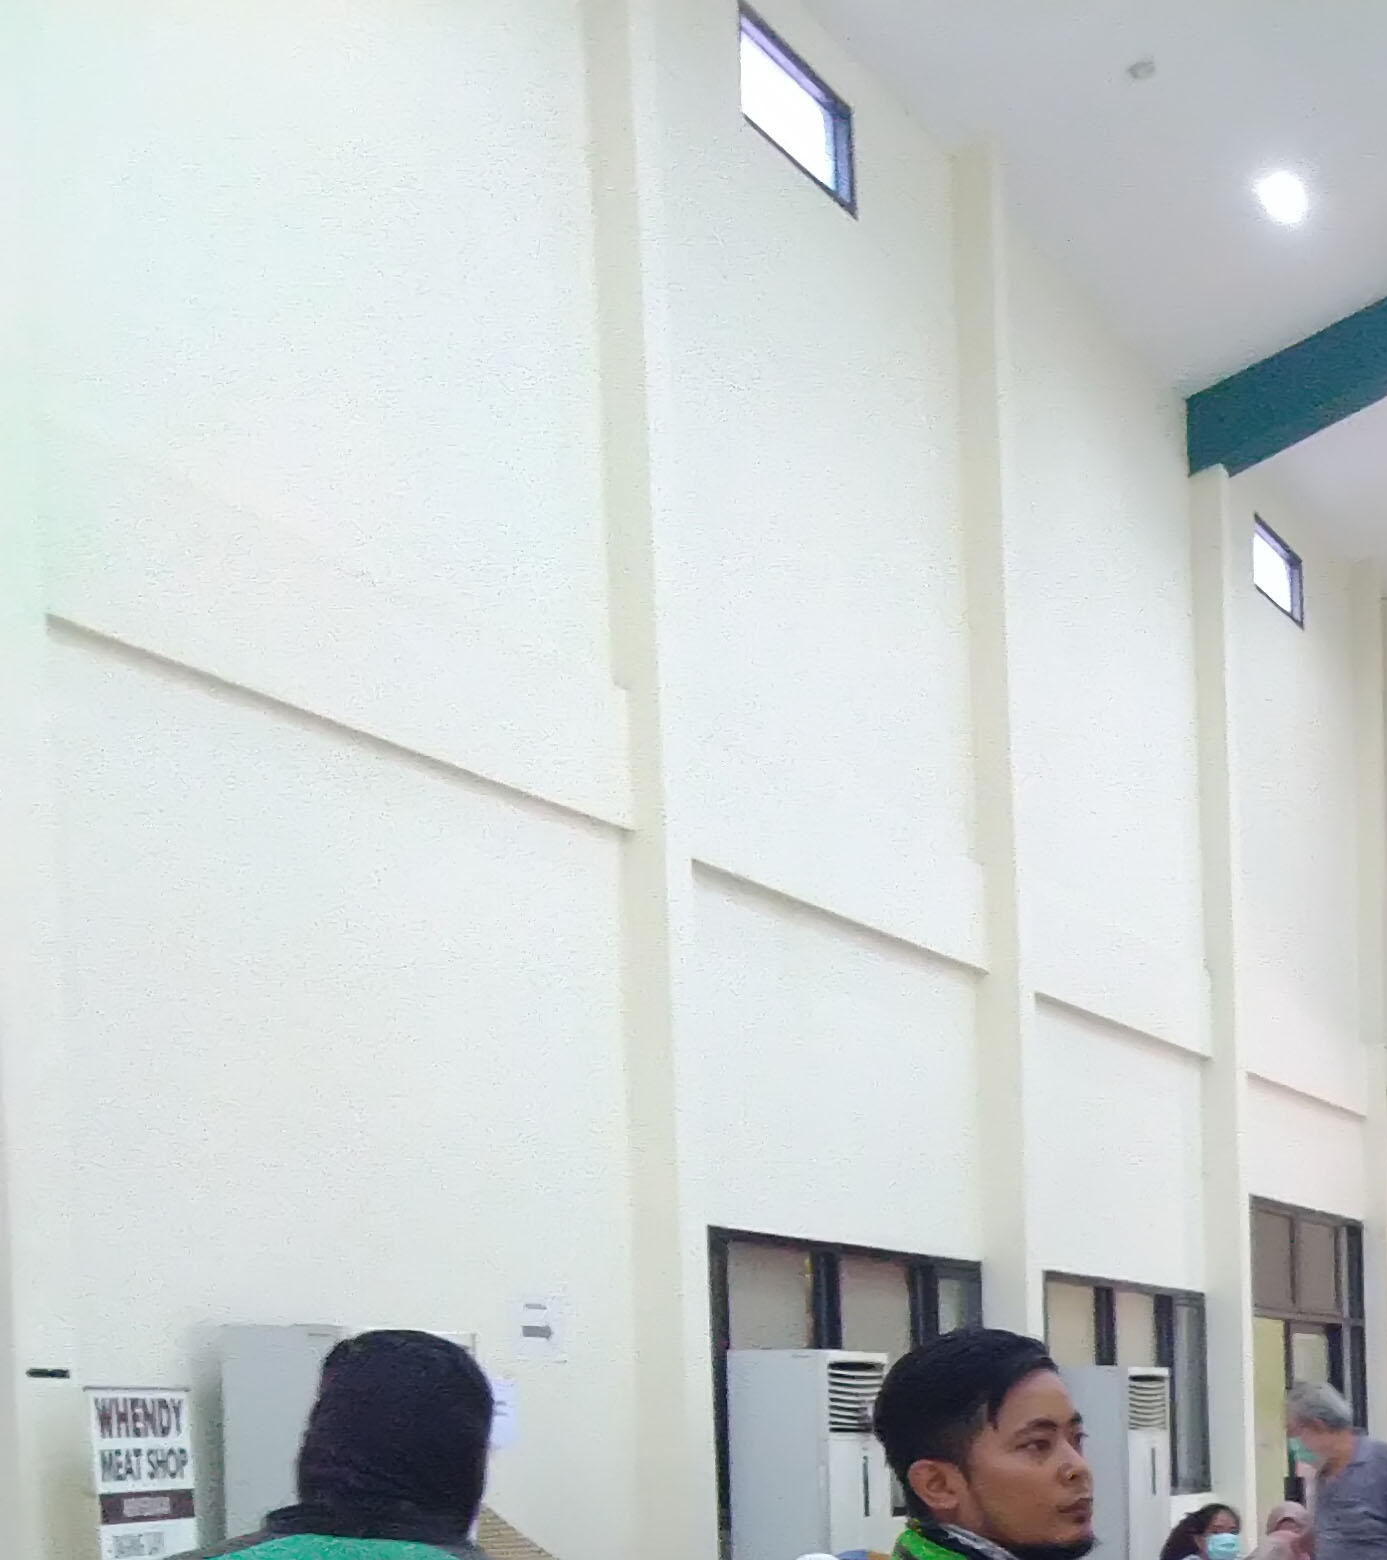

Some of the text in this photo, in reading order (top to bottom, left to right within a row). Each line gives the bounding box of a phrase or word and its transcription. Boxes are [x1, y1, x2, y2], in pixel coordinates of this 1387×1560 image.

[94, 1397, 184, 1439] WHENDY
[101, 1448, 188, 1483] MEAT SHOP
